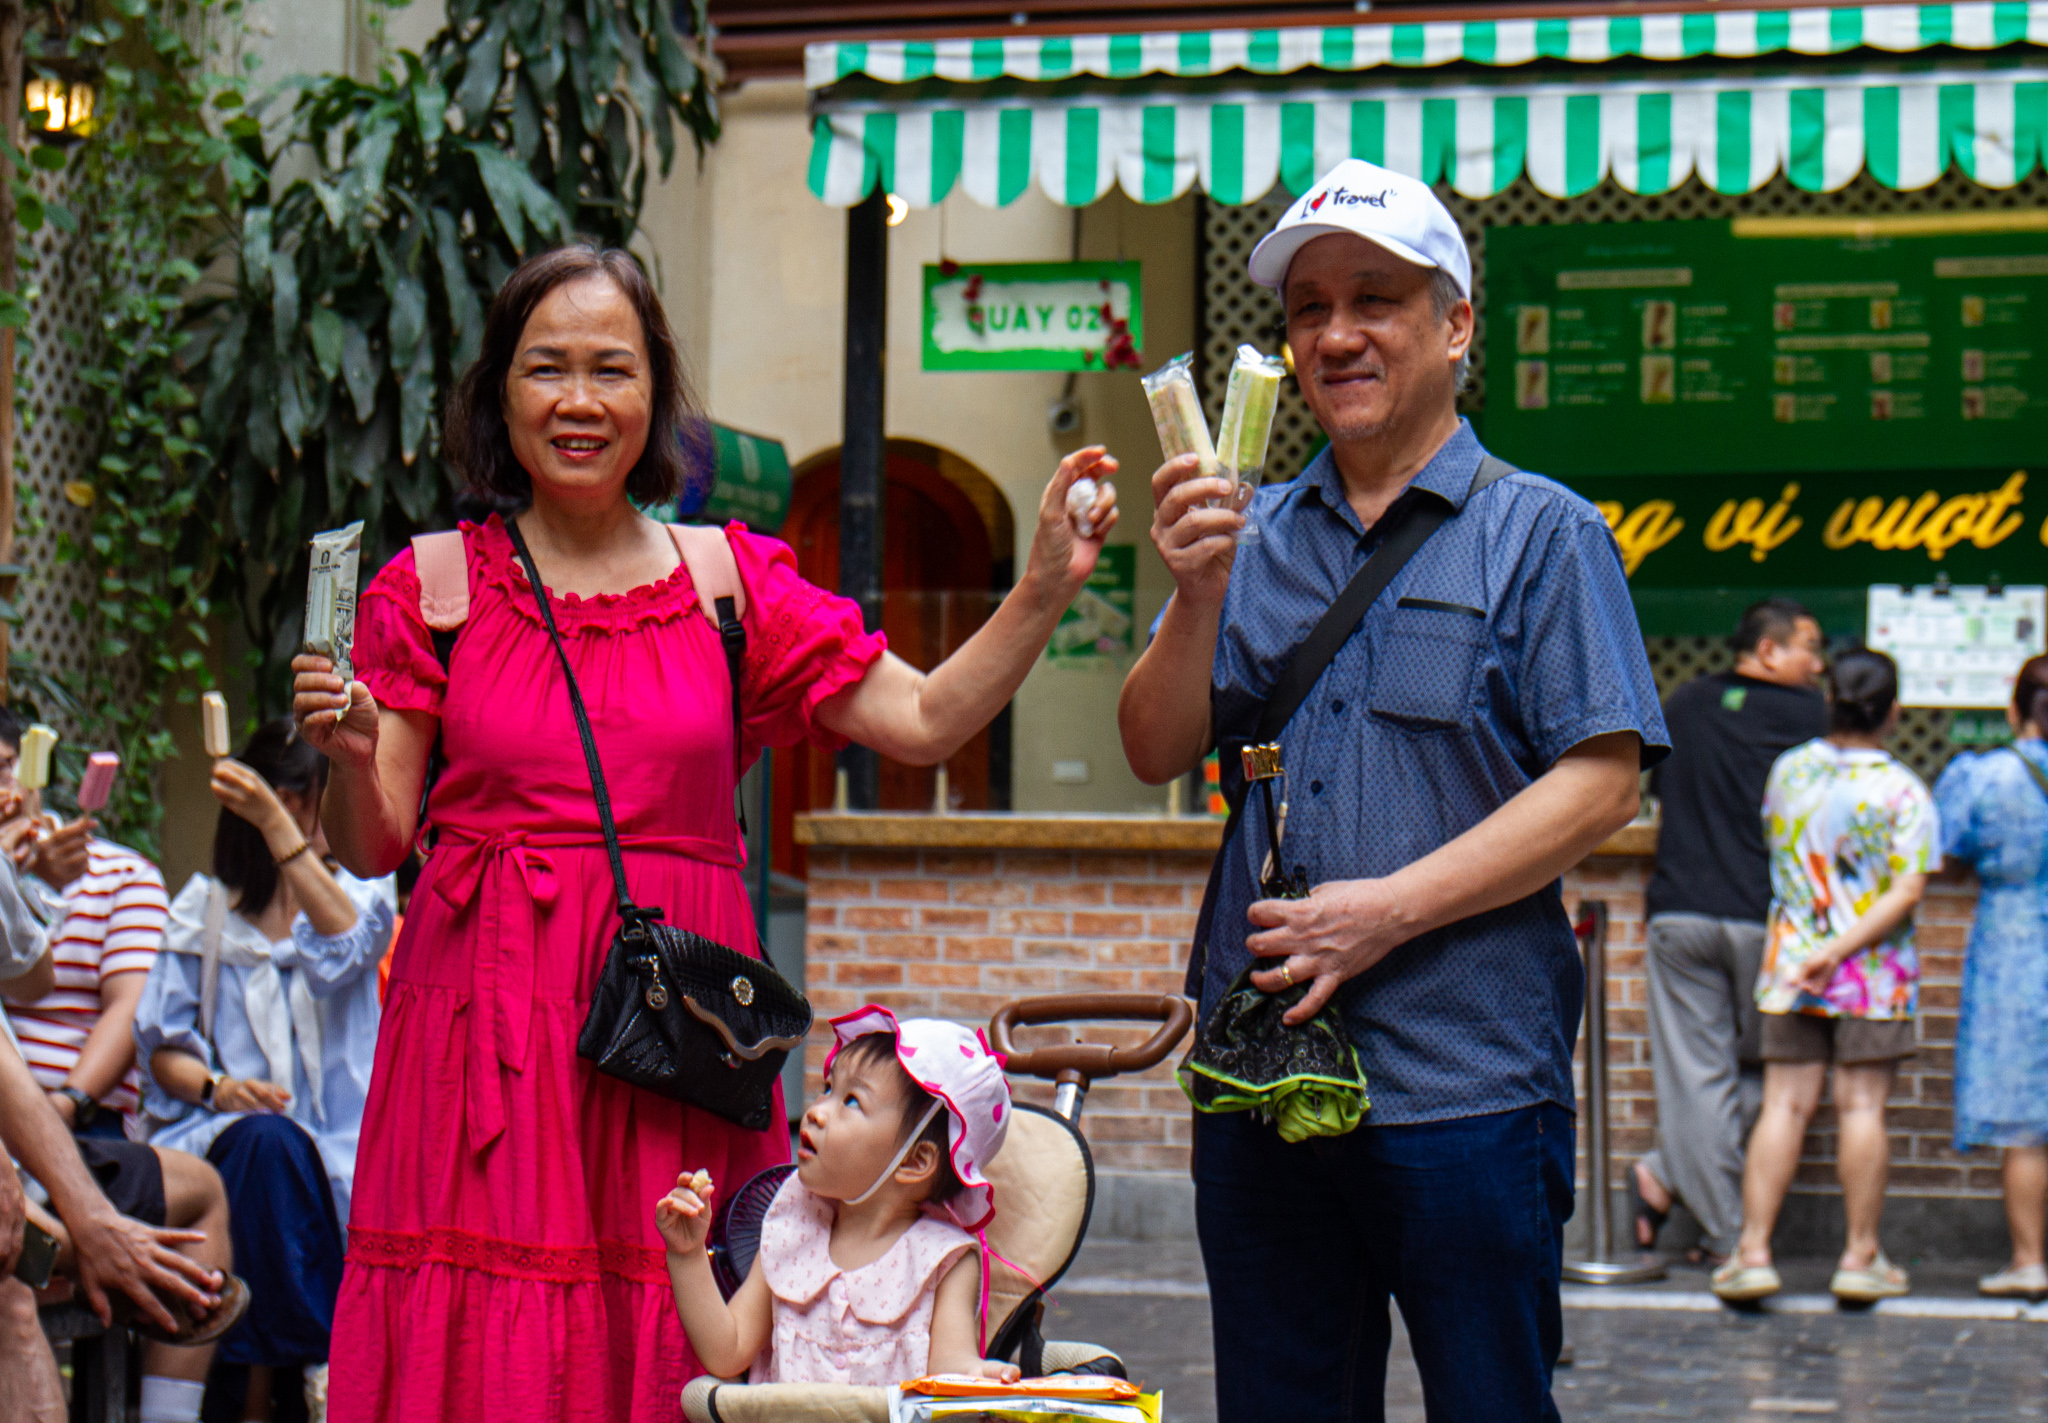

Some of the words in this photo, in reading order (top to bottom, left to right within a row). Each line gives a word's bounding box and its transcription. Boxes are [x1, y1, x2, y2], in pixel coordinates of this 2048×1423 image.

[1300, 197, 1312, 219] I
[1333, 186, 1387, 209] travel
[1066, 303, 1102, 332] 02
[1702, 480, 1803, 563] vị
